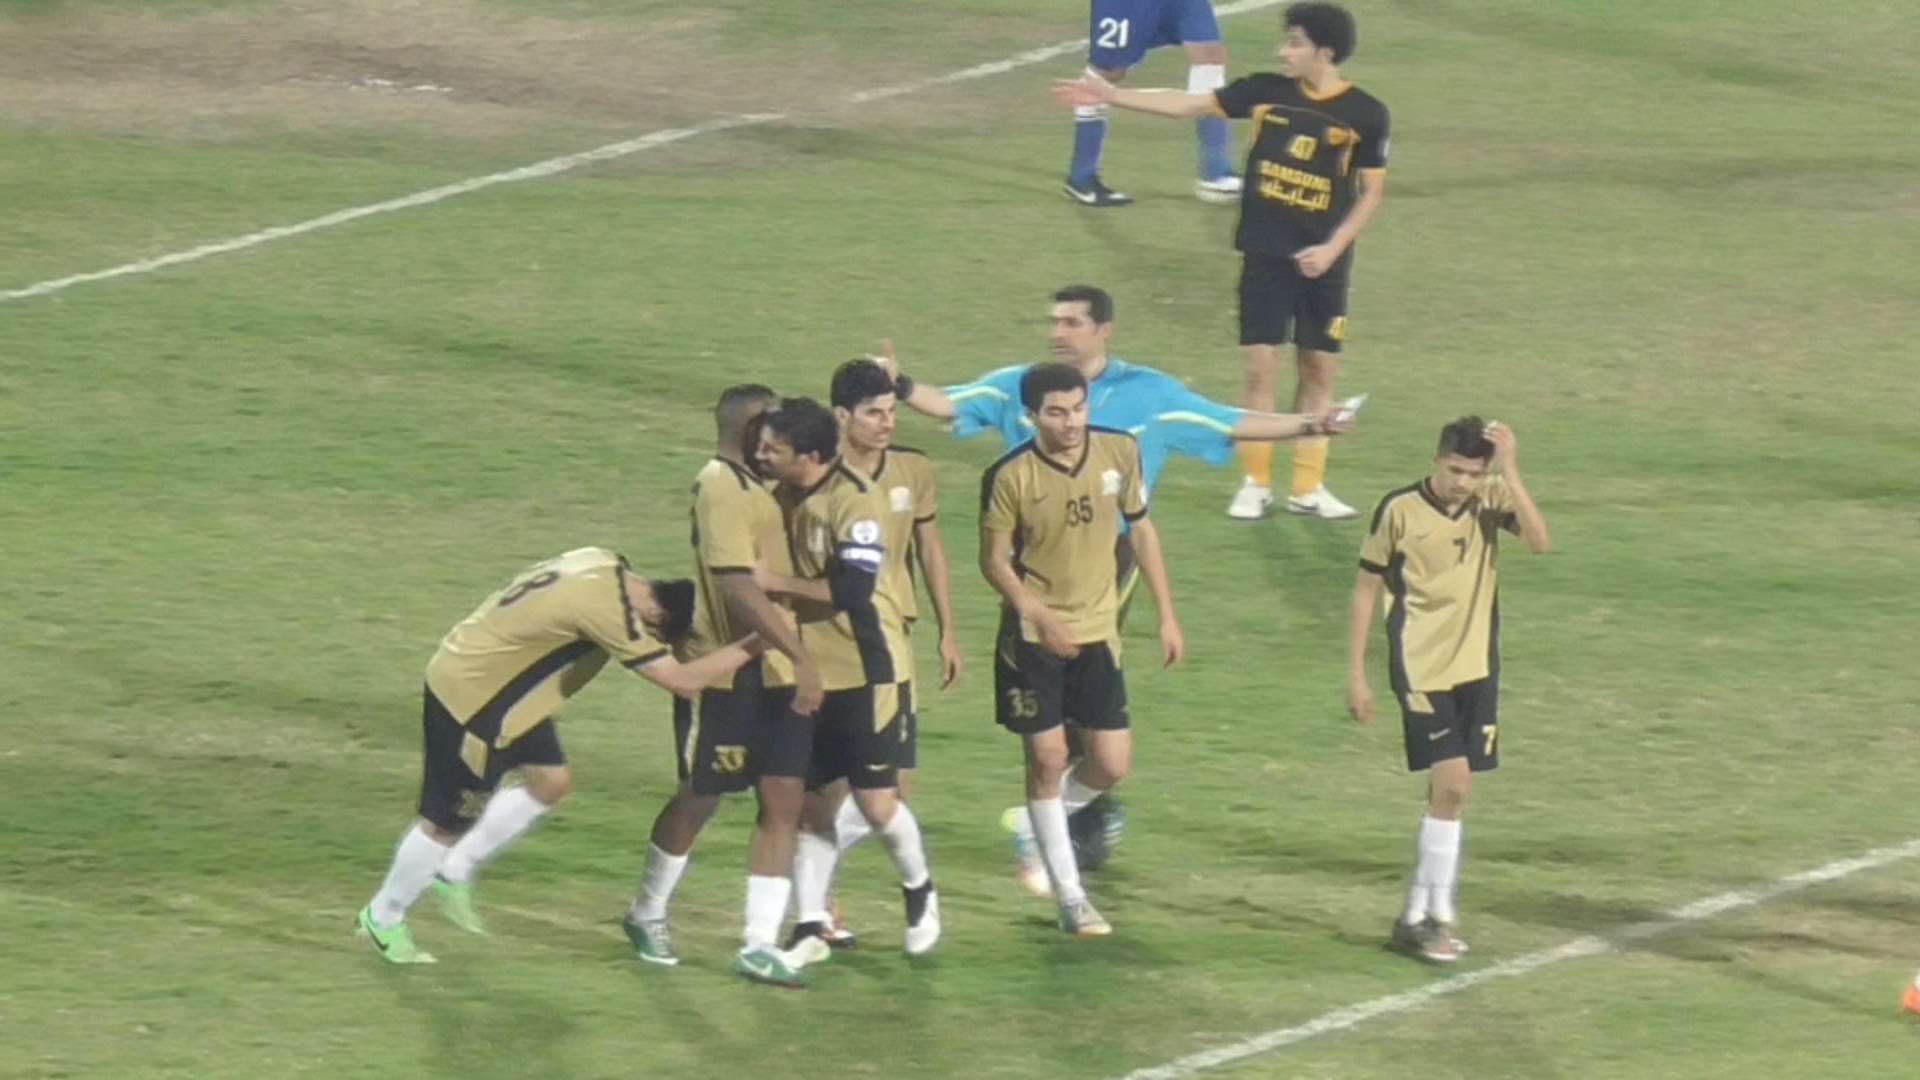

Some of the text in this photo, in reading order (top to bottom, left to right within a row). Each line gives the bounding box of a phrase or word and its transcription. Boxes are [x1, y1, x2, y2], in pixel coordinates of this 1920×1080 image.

[1098, 17, 1129, 48] 21
[1066, 495, 1093, 527] 35
[1453, 537, 1466, 563] 7
[1482, 725, 1496, 755] 7
